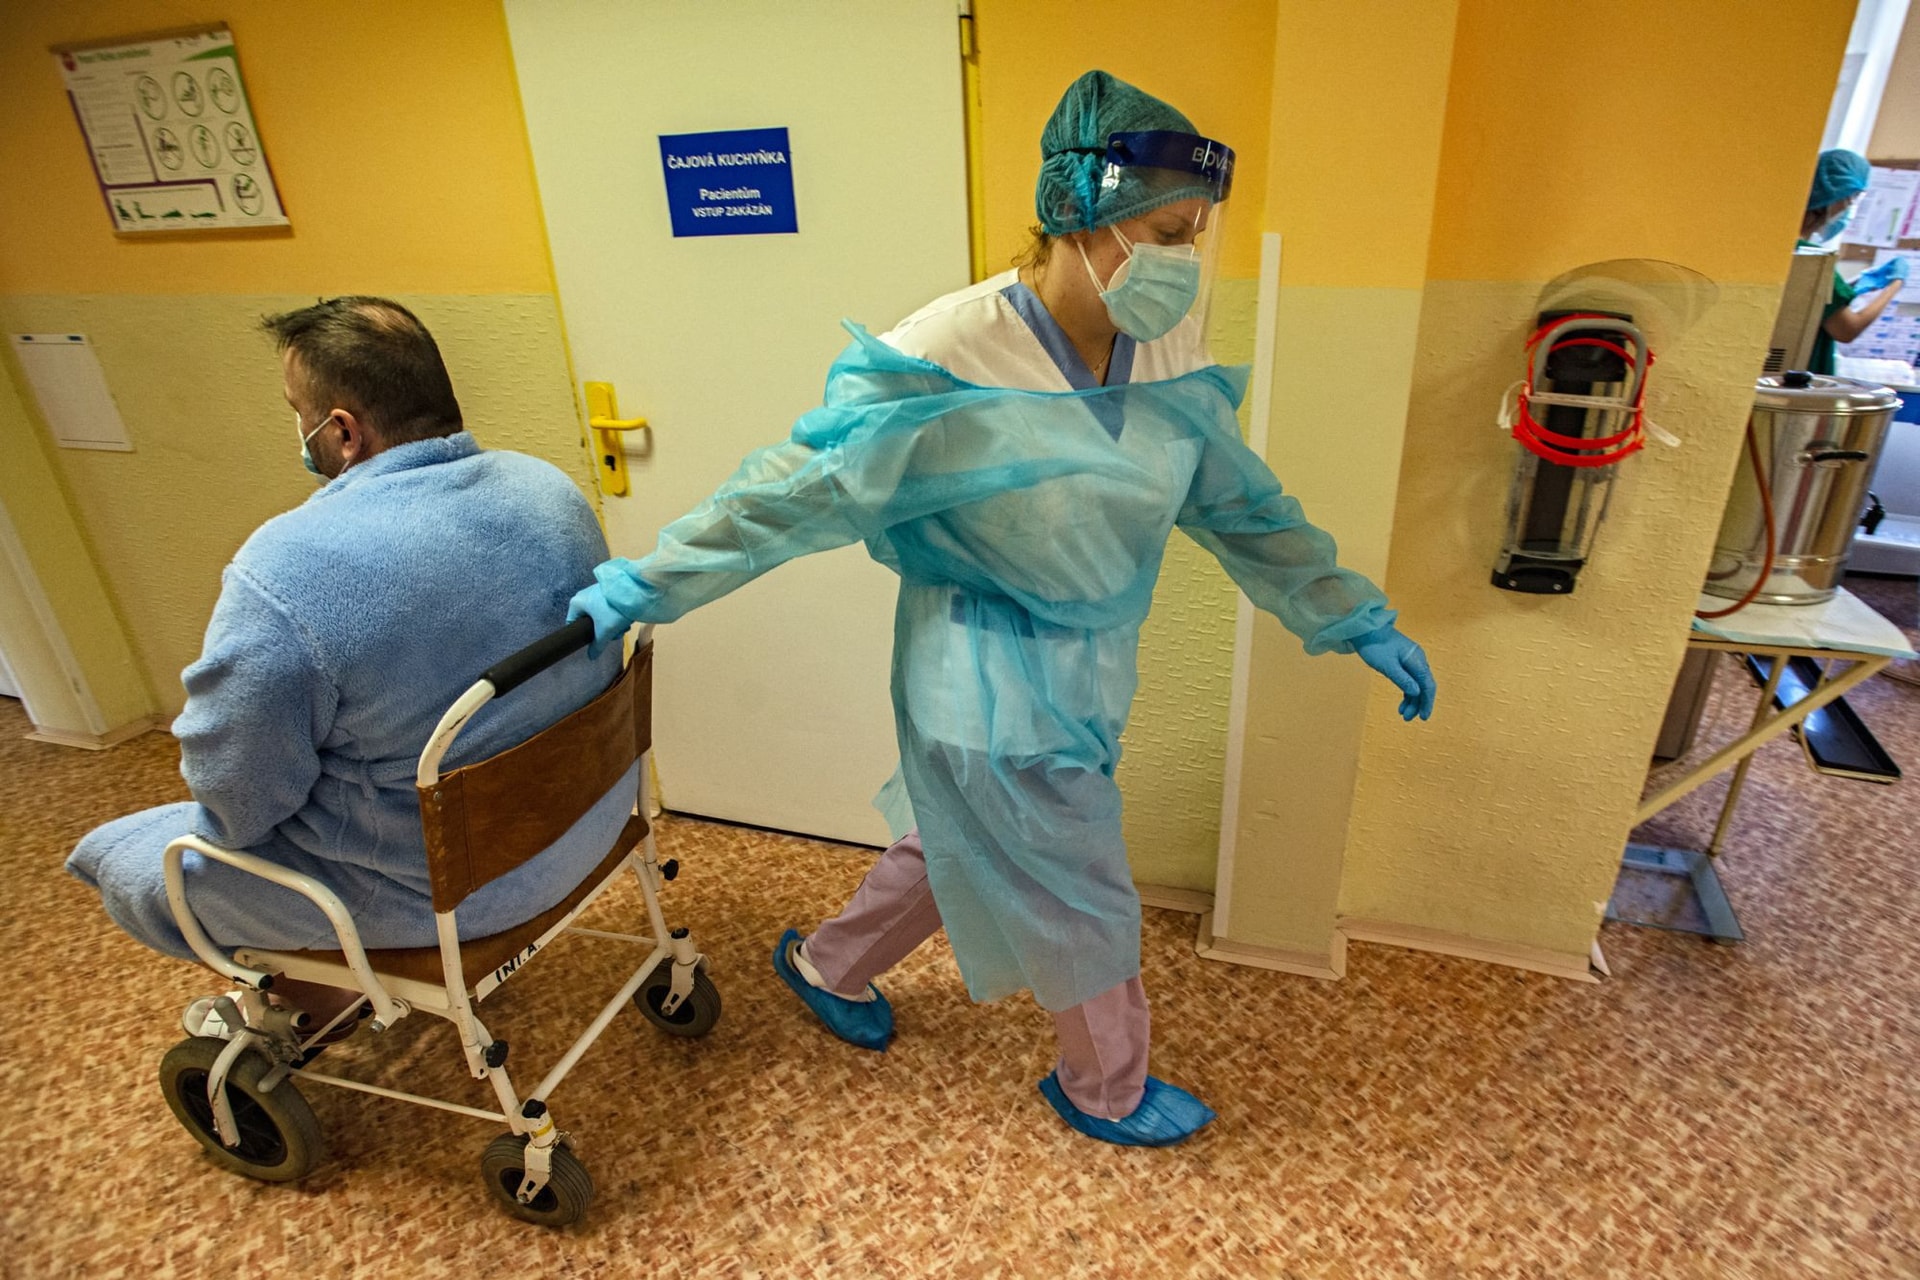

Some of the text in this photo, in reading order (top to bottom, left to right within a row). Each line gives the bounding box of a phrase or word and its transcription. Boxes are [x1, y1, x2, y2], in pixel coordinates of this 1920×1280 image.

[667, 149, 787, 169] ČAJOVÁ KUCHYŇKA
[699, 186, 761, 201] Pacientům
[691, 203, 773, 218] VSTUP ZAKÁZÁN
